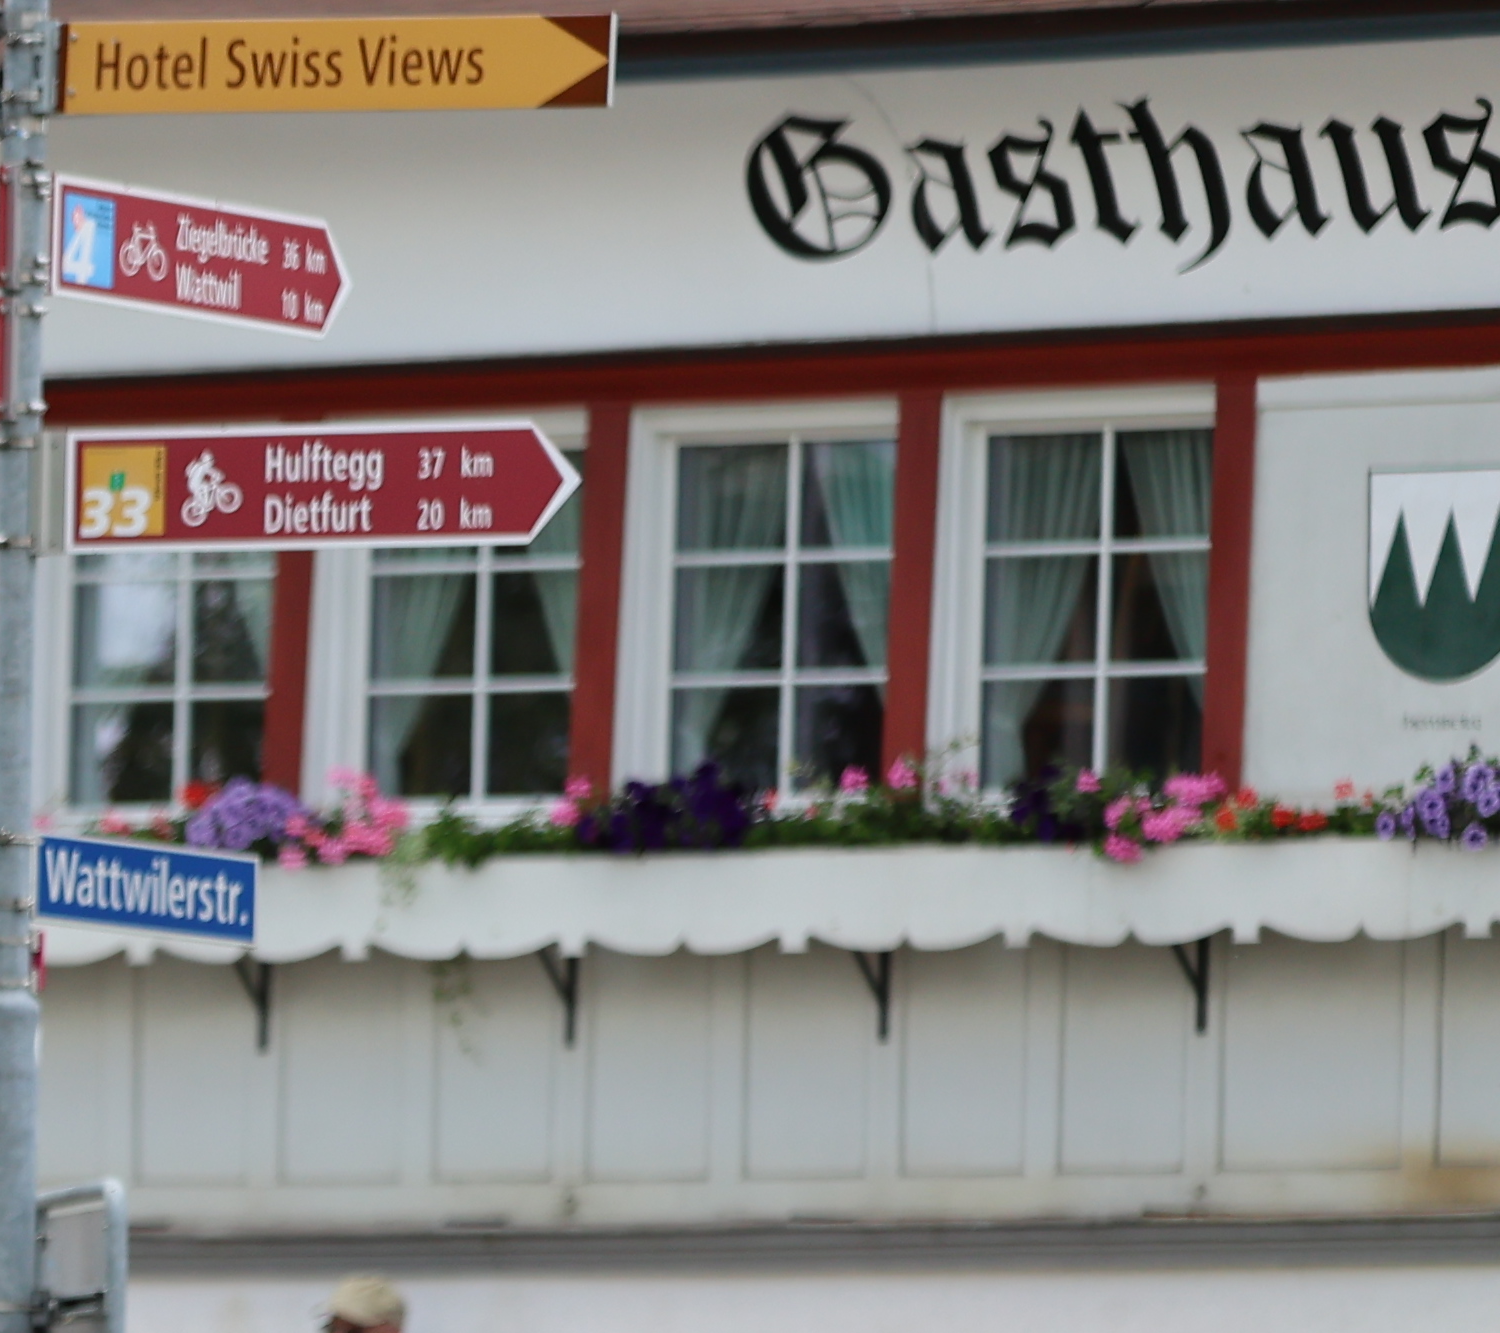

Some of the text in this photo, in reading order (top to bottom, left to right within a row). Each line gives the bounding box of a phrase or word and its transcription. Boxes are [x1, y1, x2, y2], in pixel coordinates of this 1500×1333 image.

[95, 33, 485, 91] Hotel Swiss Views
[745, 95, 1500, 277] Gasthaus
[62, 215, 95, 285] 4
[177, 212, 270, 266] Ziegelbrücke
[304, 239, 326, 276] km
[175, 262, 242, 311] Wattwil
[304, 290, 325, 325] km
[265, 443, 493, 491] Hulftegg 37 km
[80, 489, 150, 538] 33
[264, 494, 492, 535] Dietfurt 20 km
[44, 845, 250, 928] Wattwilerstr.
